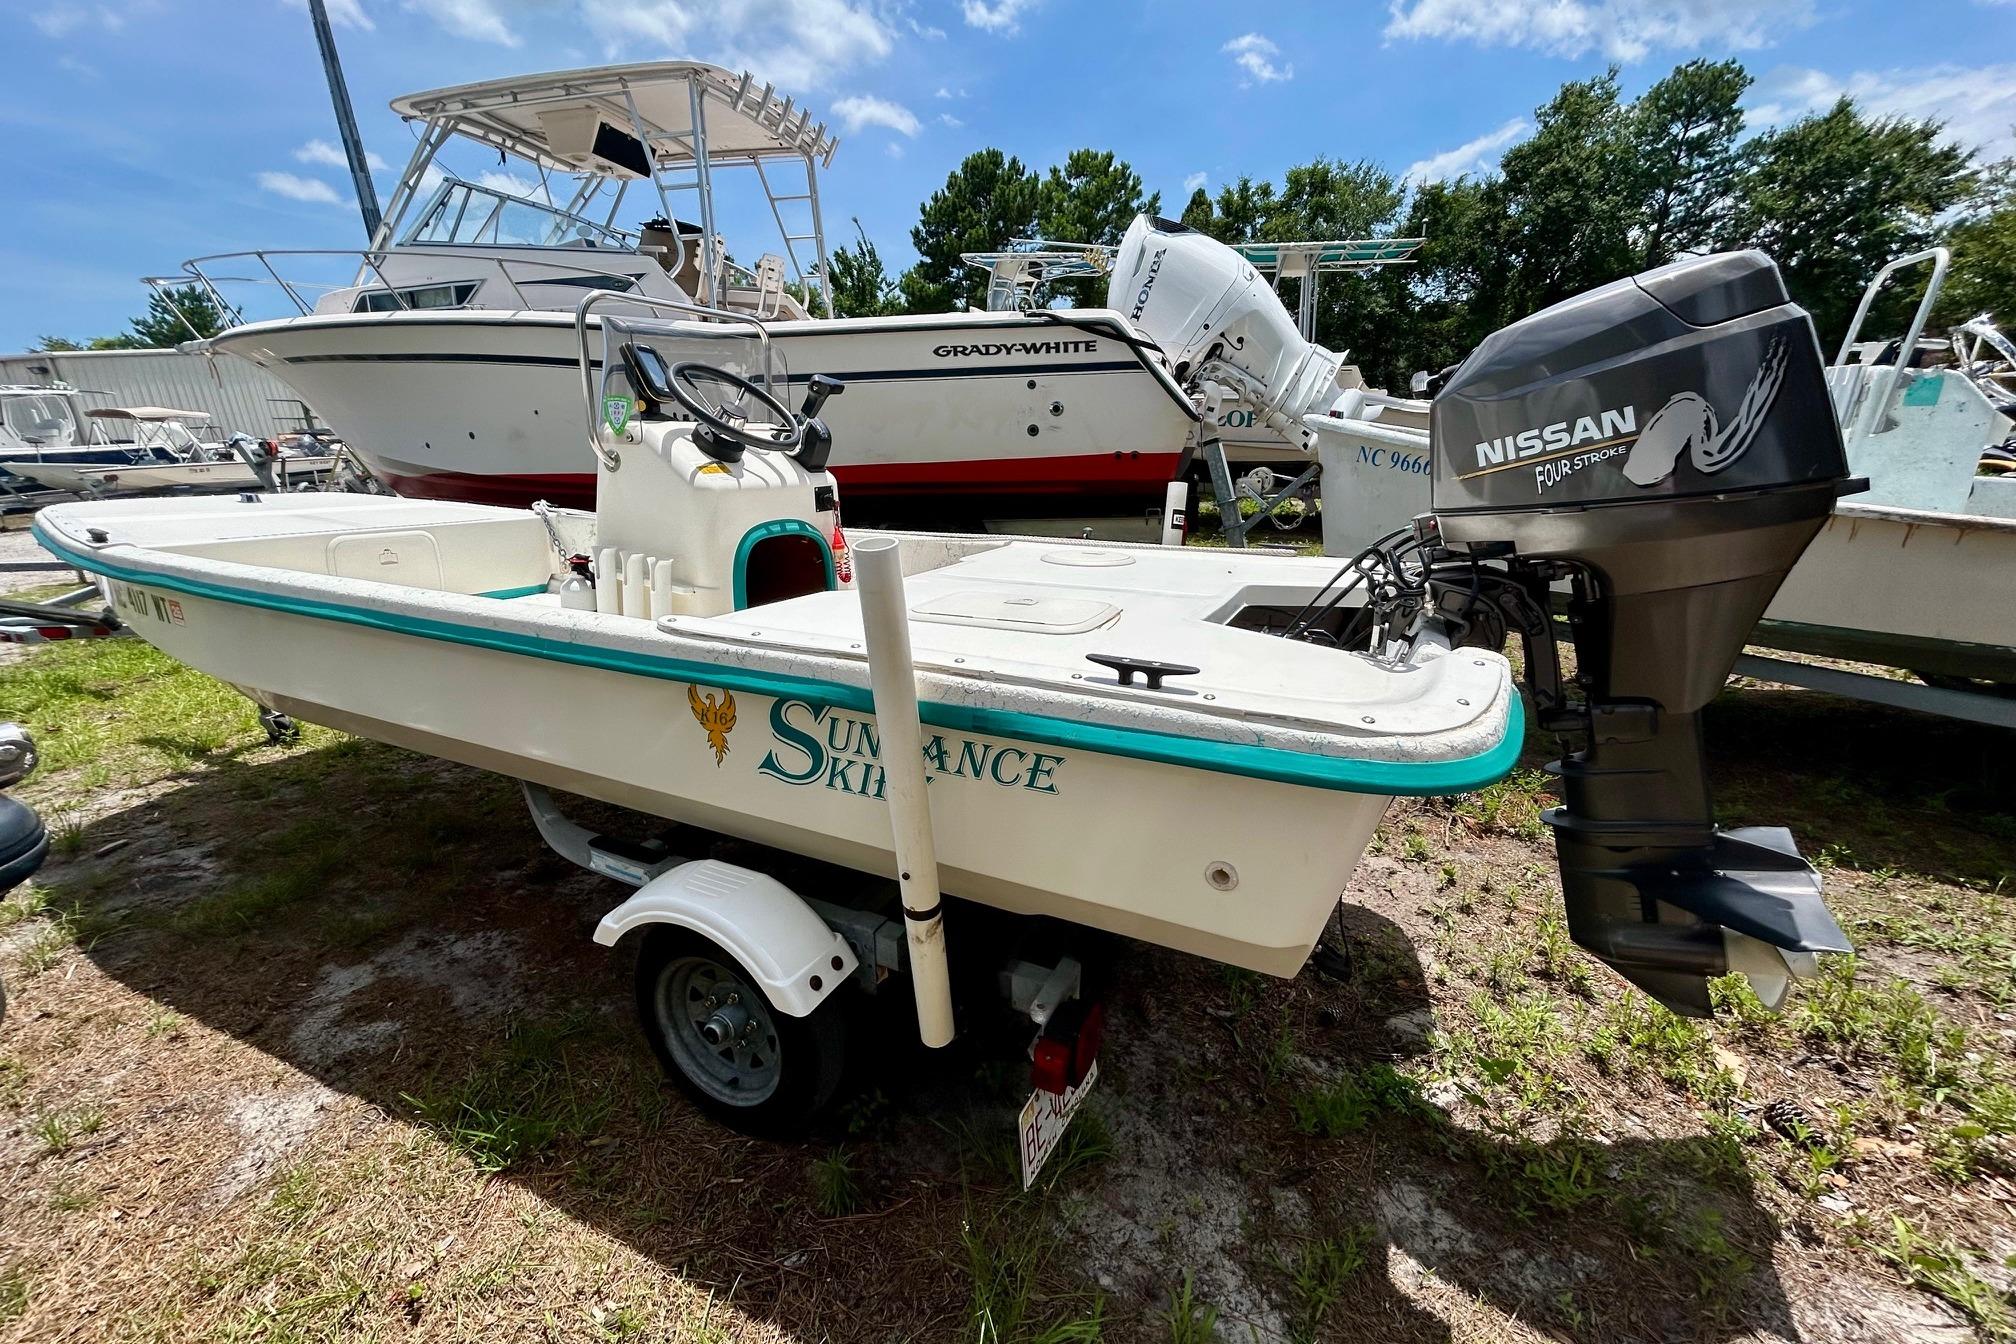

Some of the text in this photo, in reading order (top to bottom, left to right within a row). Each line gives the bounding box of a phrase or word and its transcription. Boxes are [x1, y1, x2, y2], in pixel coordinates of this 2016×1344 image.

[1130, 248, 1167, 322] HONDA
[932, 340, 1098, 358] GRADY-WHITE
[1356, 445, 1386, 467] NC
[1475, 405, 1637, 468] NISSAN
[1535, 445, 1627, 495] FOUR STROKE
[757, 697, 1067, 798] SUNANCE
